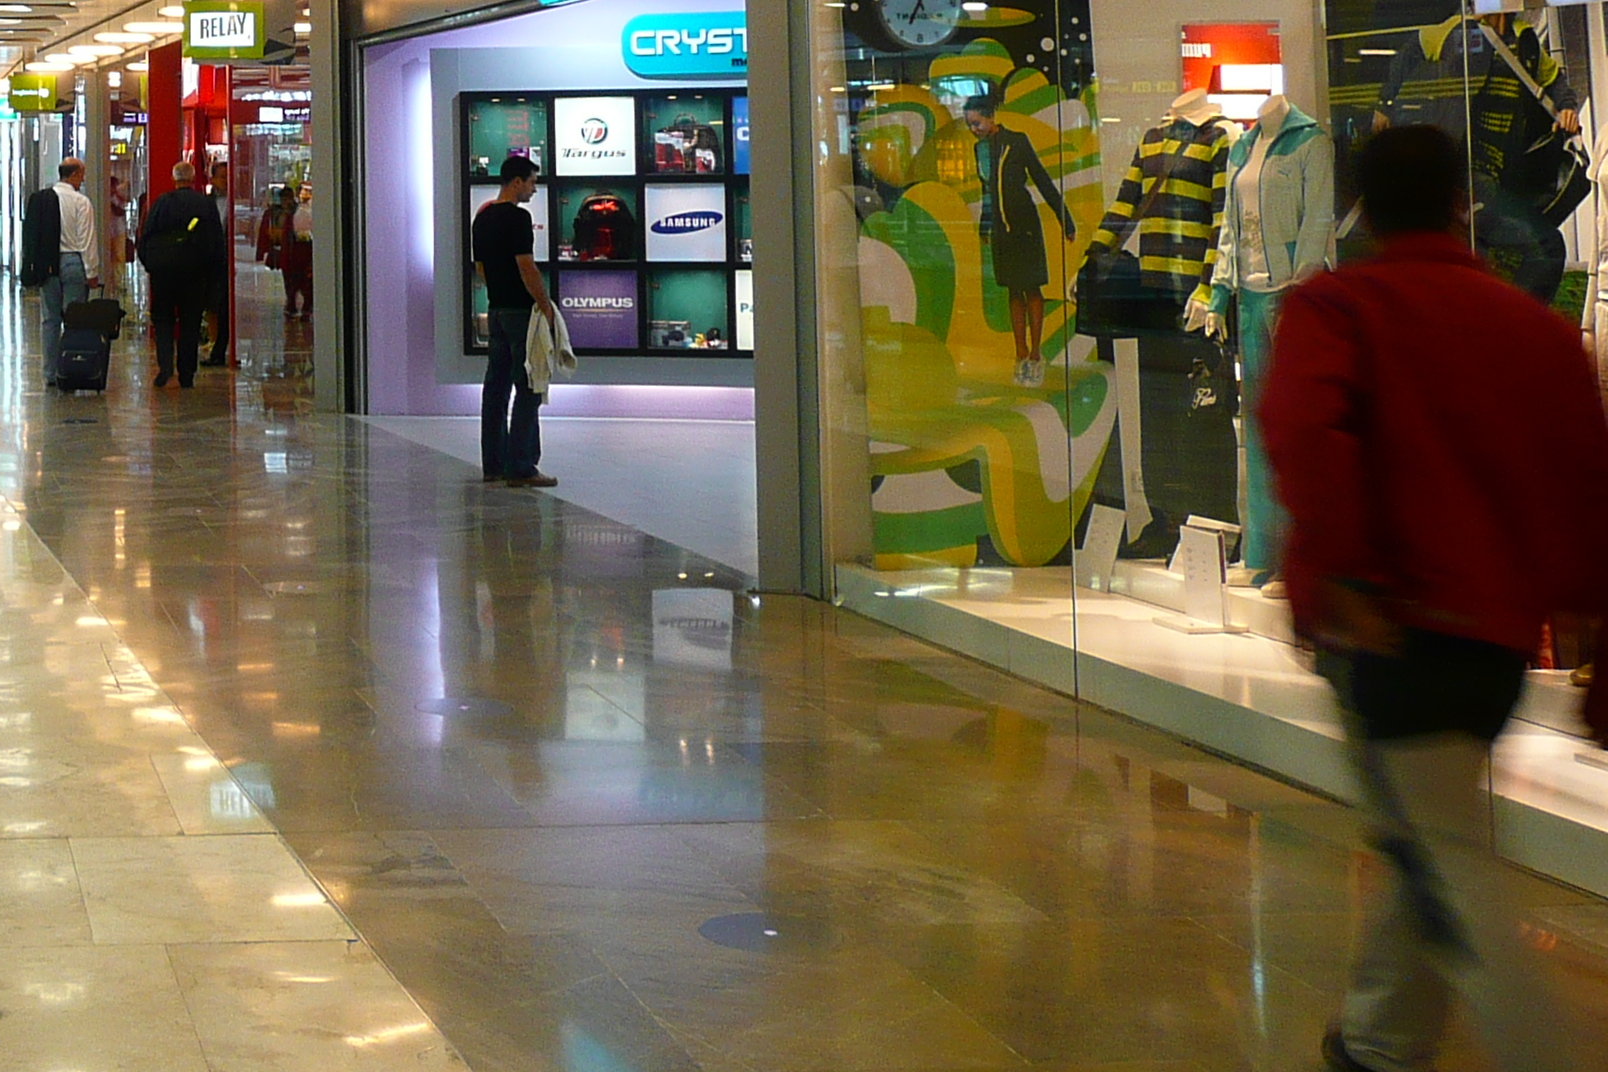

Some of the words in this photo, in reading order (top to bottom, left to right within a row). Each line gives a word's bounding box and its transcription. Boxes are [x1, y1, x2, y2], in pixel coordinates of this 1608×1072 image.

[200, 12, 247, 40] RELAY
[630, 27, 748, 57] CRYST
[560, 147, 627, 160] Targus
[659, 217, 717, 228] SAMSUNG
[561, 296, 634, 308] OLYMPUS
